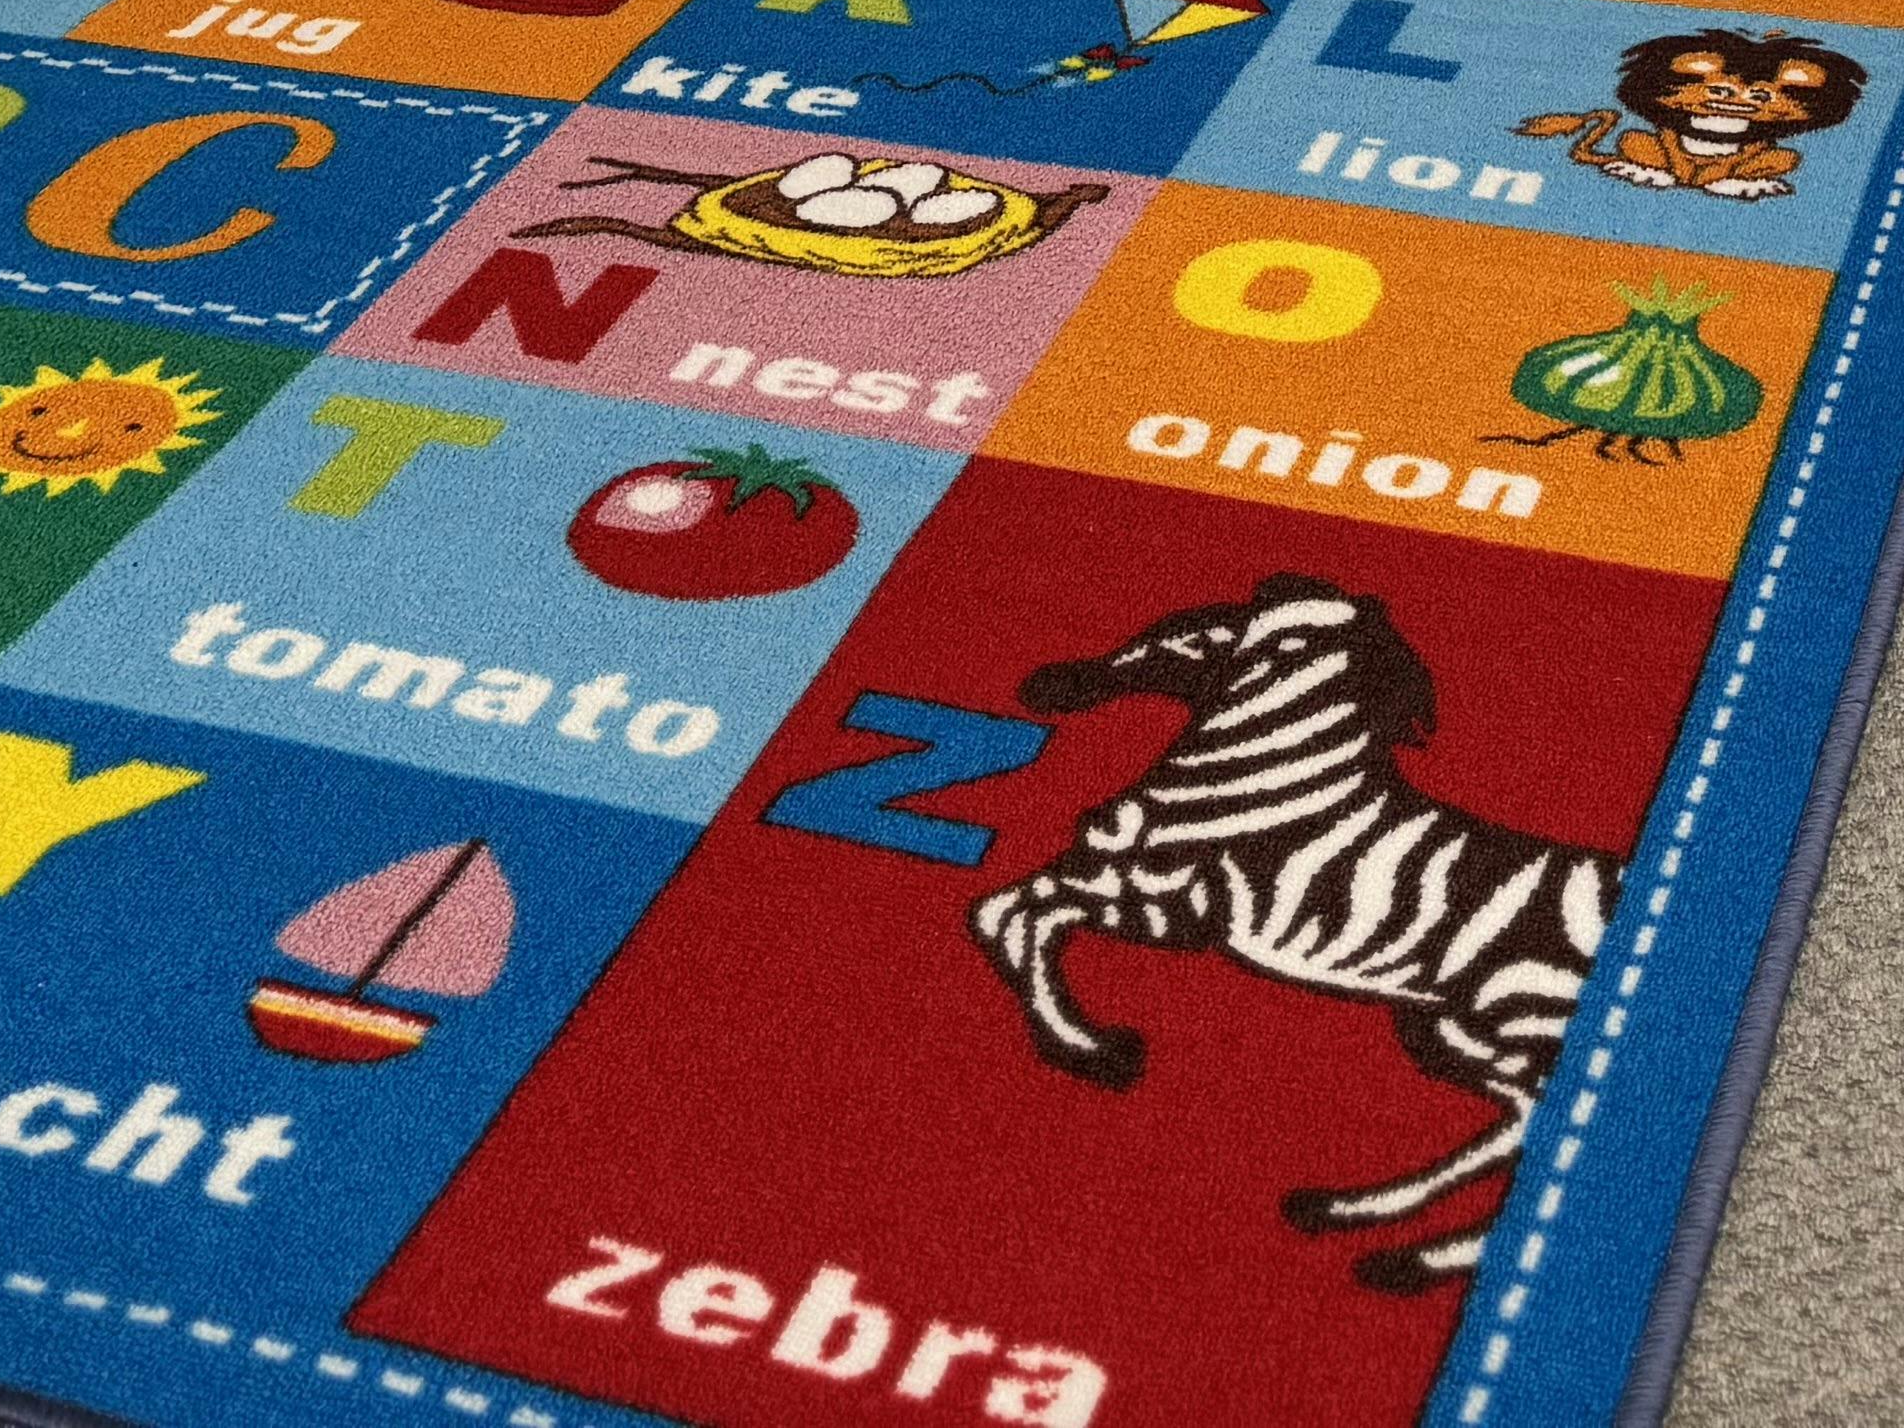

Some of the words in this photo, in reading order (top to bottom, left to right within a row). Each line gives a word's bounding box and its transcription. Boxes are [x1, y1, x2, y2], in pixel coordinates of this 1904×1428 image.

[621, 54, 862, 117] kite
[1299, 131, 1545, 205] lion
[411, 248, 664, 364] N
[1172, 238, 1384, 343] O
[668, 336, 1003, 428] nest
[286, 392, 505, 518] T
[1127, 410, 1544, 522] onion
[166, 598, 720, 760] tomato
[757, 687, 1054, 867] Z
[545, 1235, 1109, 1428] zebra
